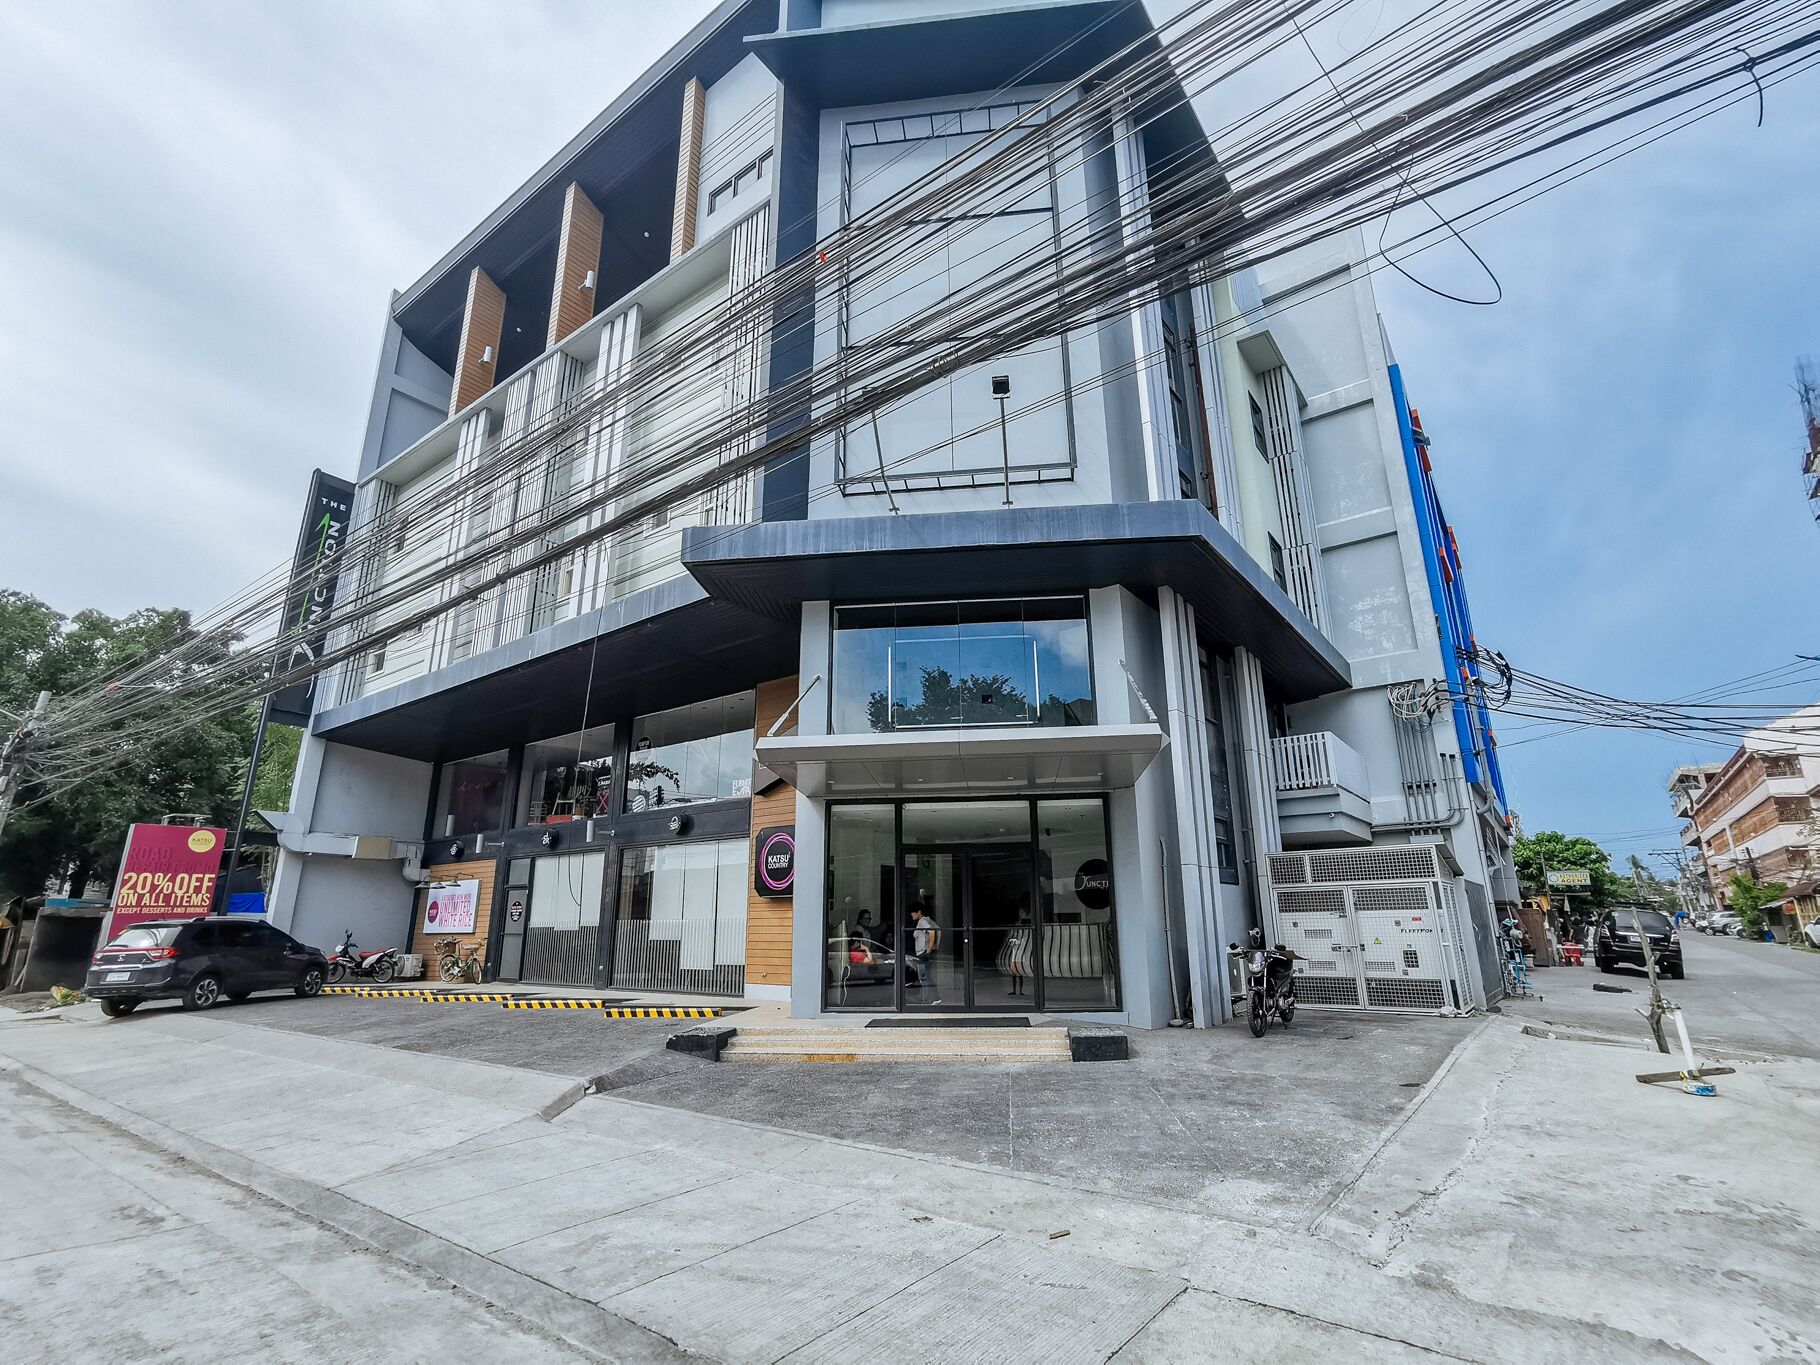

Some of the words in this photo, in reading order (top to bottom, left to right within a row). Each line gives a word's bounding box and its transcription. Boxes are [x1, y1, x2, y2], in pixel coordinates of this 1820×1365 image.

[321, 497, 347, 511] THE
[129, 847, 172, 861] ROAD
[768, 854, 790, 863] KATSU
[126, 861, 170, 873] REPAIR
[118, 893, 138, 906] ON
[141, 893, 165, 906] ALL
[170, 893, 210, 906] ITEMS
[441, 900, 471, 914] UNLIMITED
